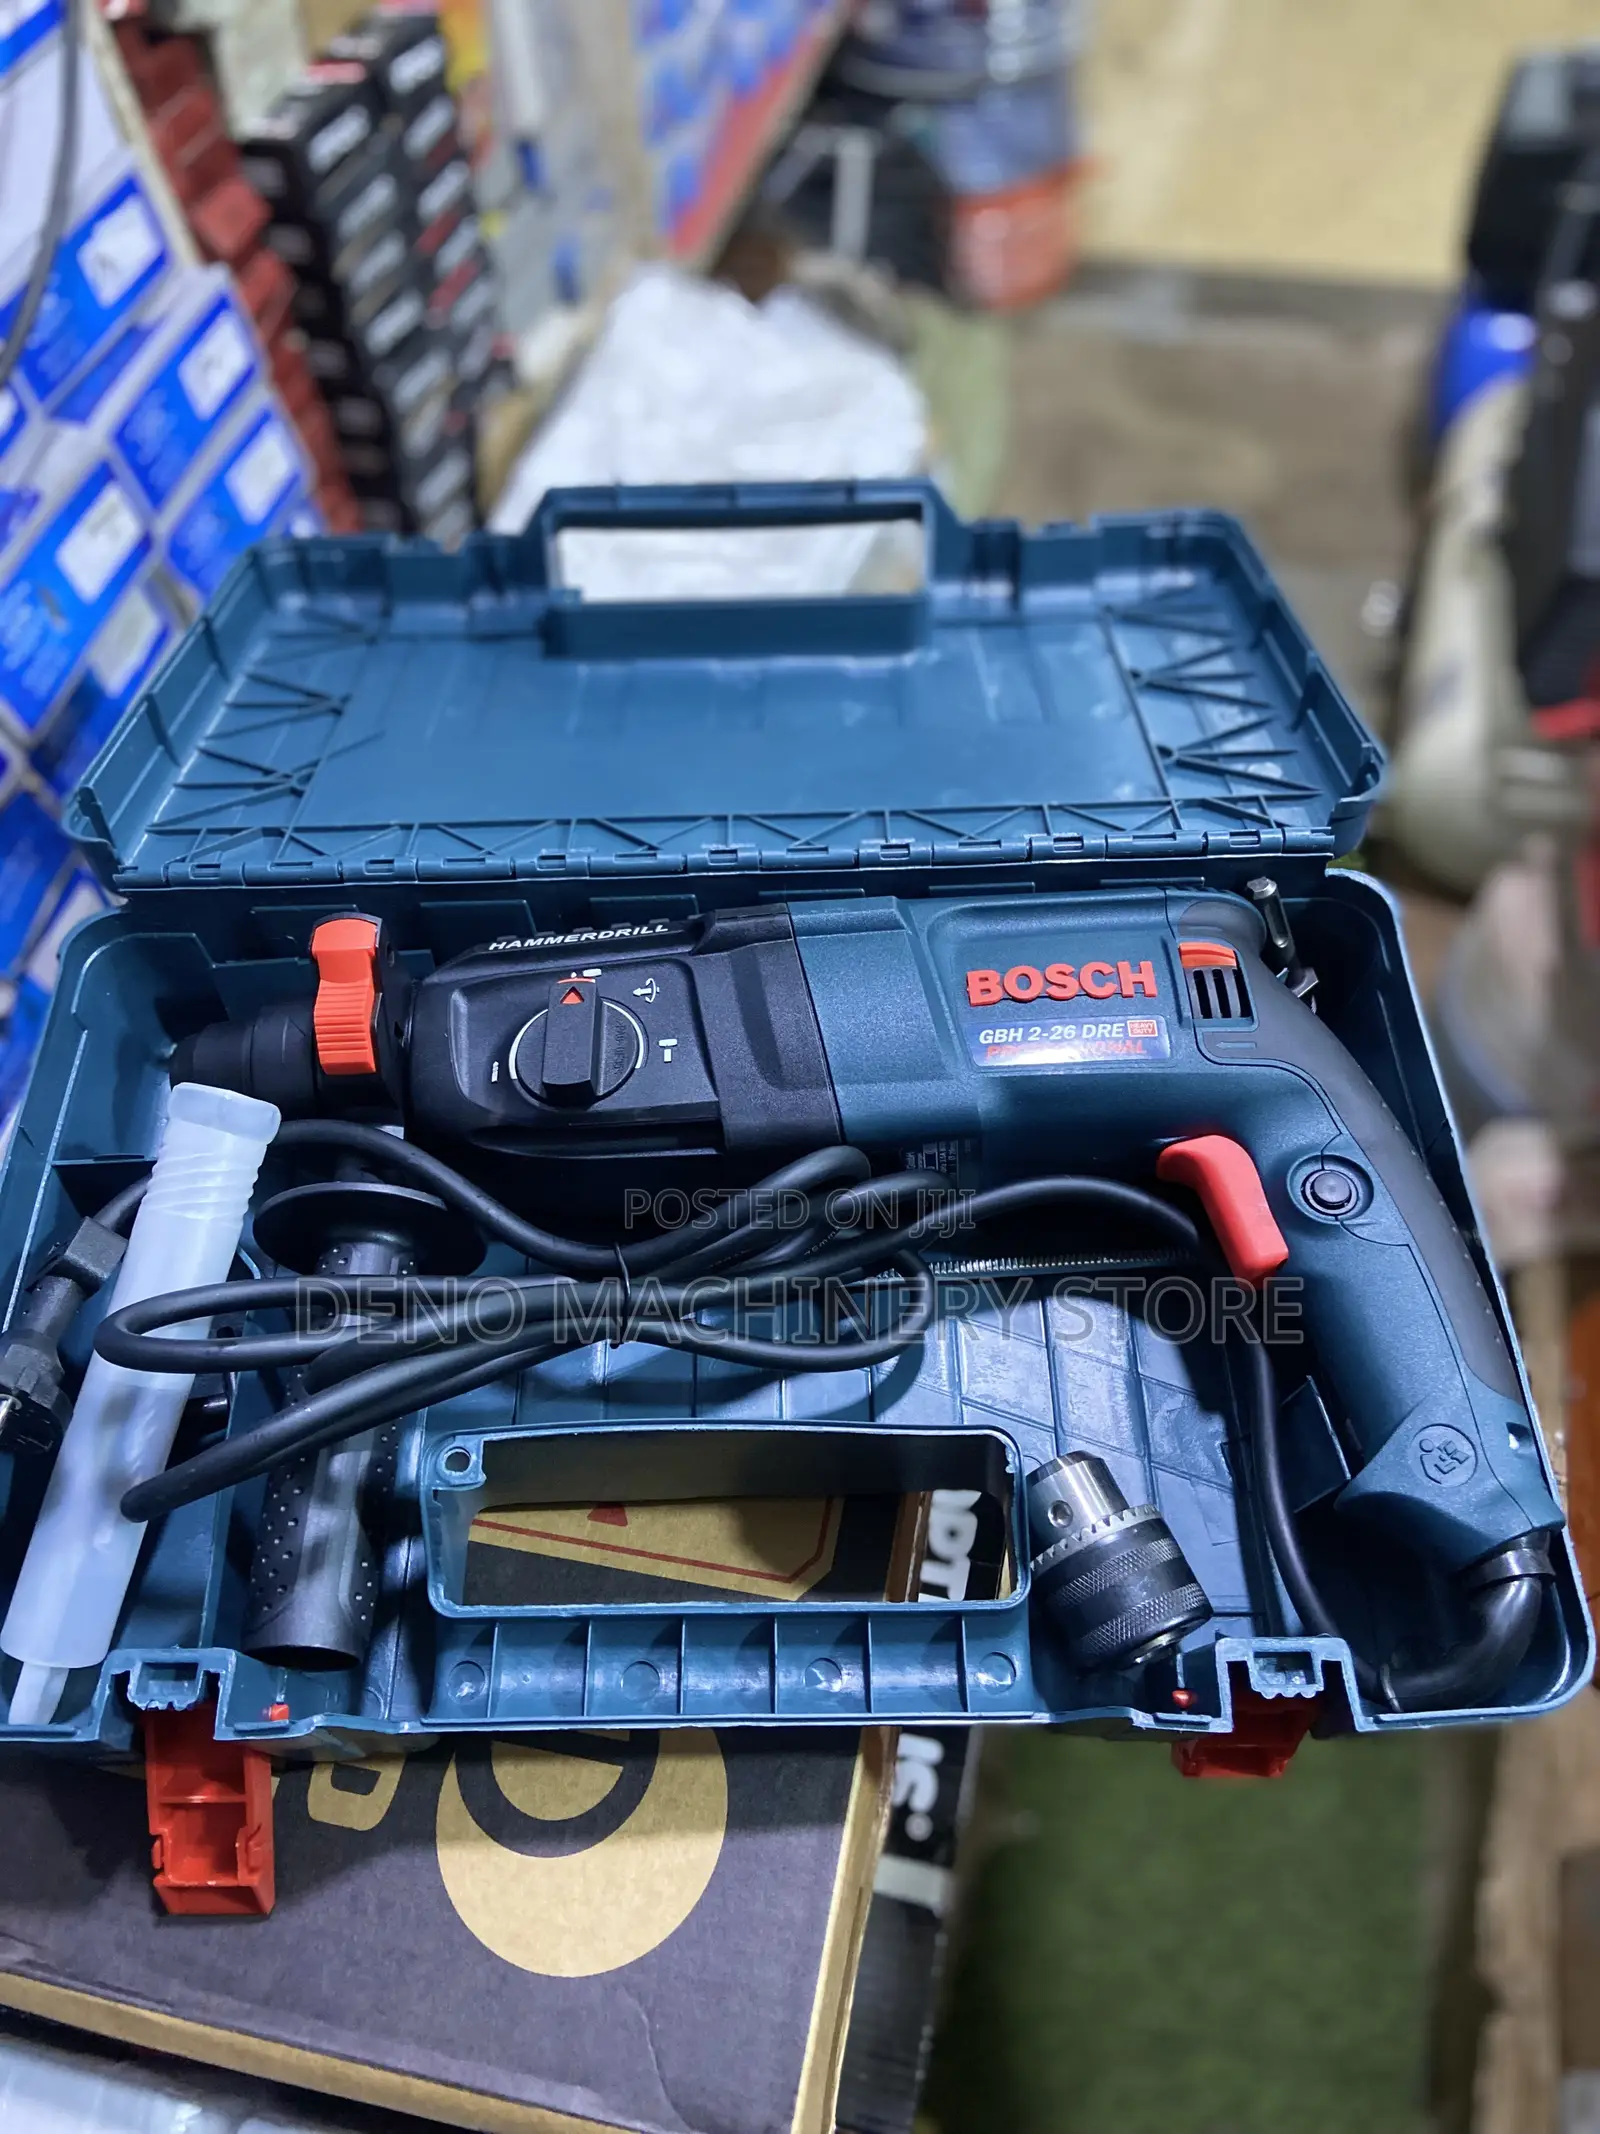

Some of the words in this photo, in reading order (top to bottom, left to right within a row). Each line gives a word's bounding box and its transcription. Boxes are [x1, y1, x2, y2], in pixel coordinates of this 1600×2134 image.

[488, 924, 669, 951] HAMMERDRILL
[966, 960, 1158, 1007] BOSCH
[979, 1027, 1023, 1045] GBH
[1028, 1024, 1076, 1042] 2-26
[1082, 1022, 1125, 1039] DRE
[1130, 1021, 1154, 1029] HEAVY
